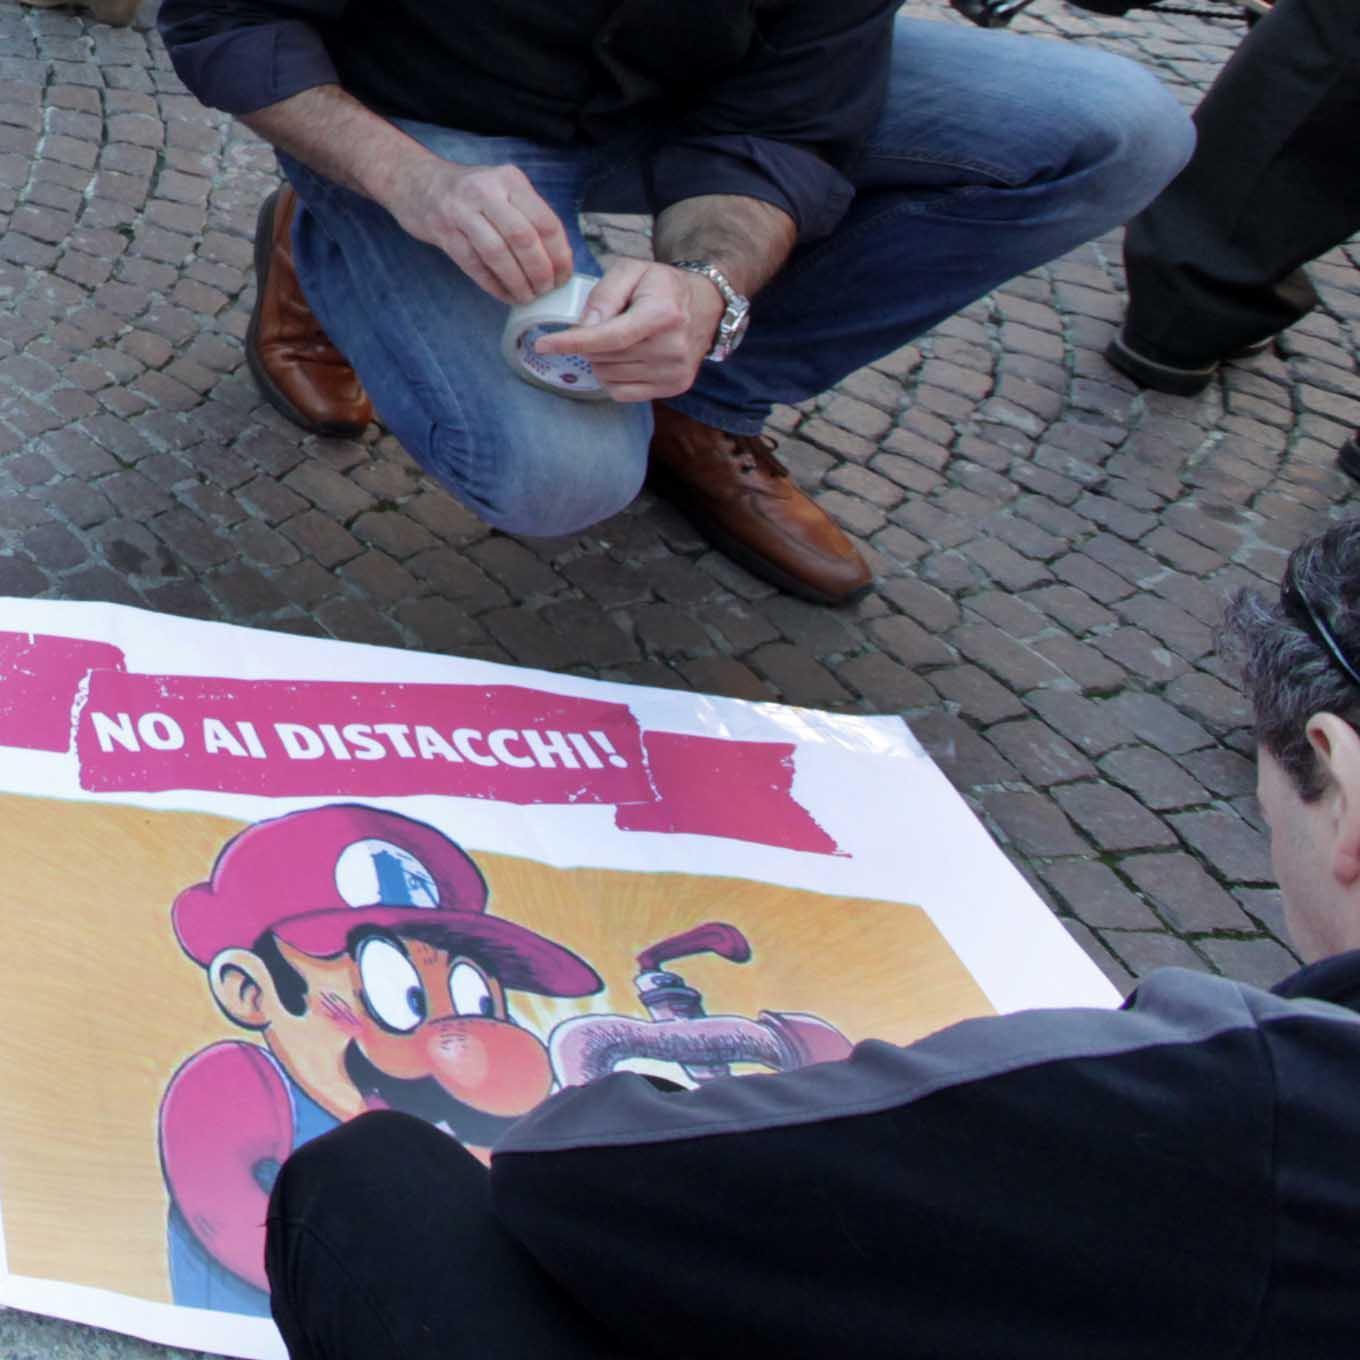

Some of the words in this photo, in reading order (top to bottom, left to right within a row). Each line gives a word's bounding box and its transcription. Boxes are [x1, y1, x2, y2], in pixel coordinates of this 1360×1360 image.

[90, 710, 184, 753] NO
[201, 718, 267, 759] AI
[273, 722, 630, 770] DISTACCHI!
